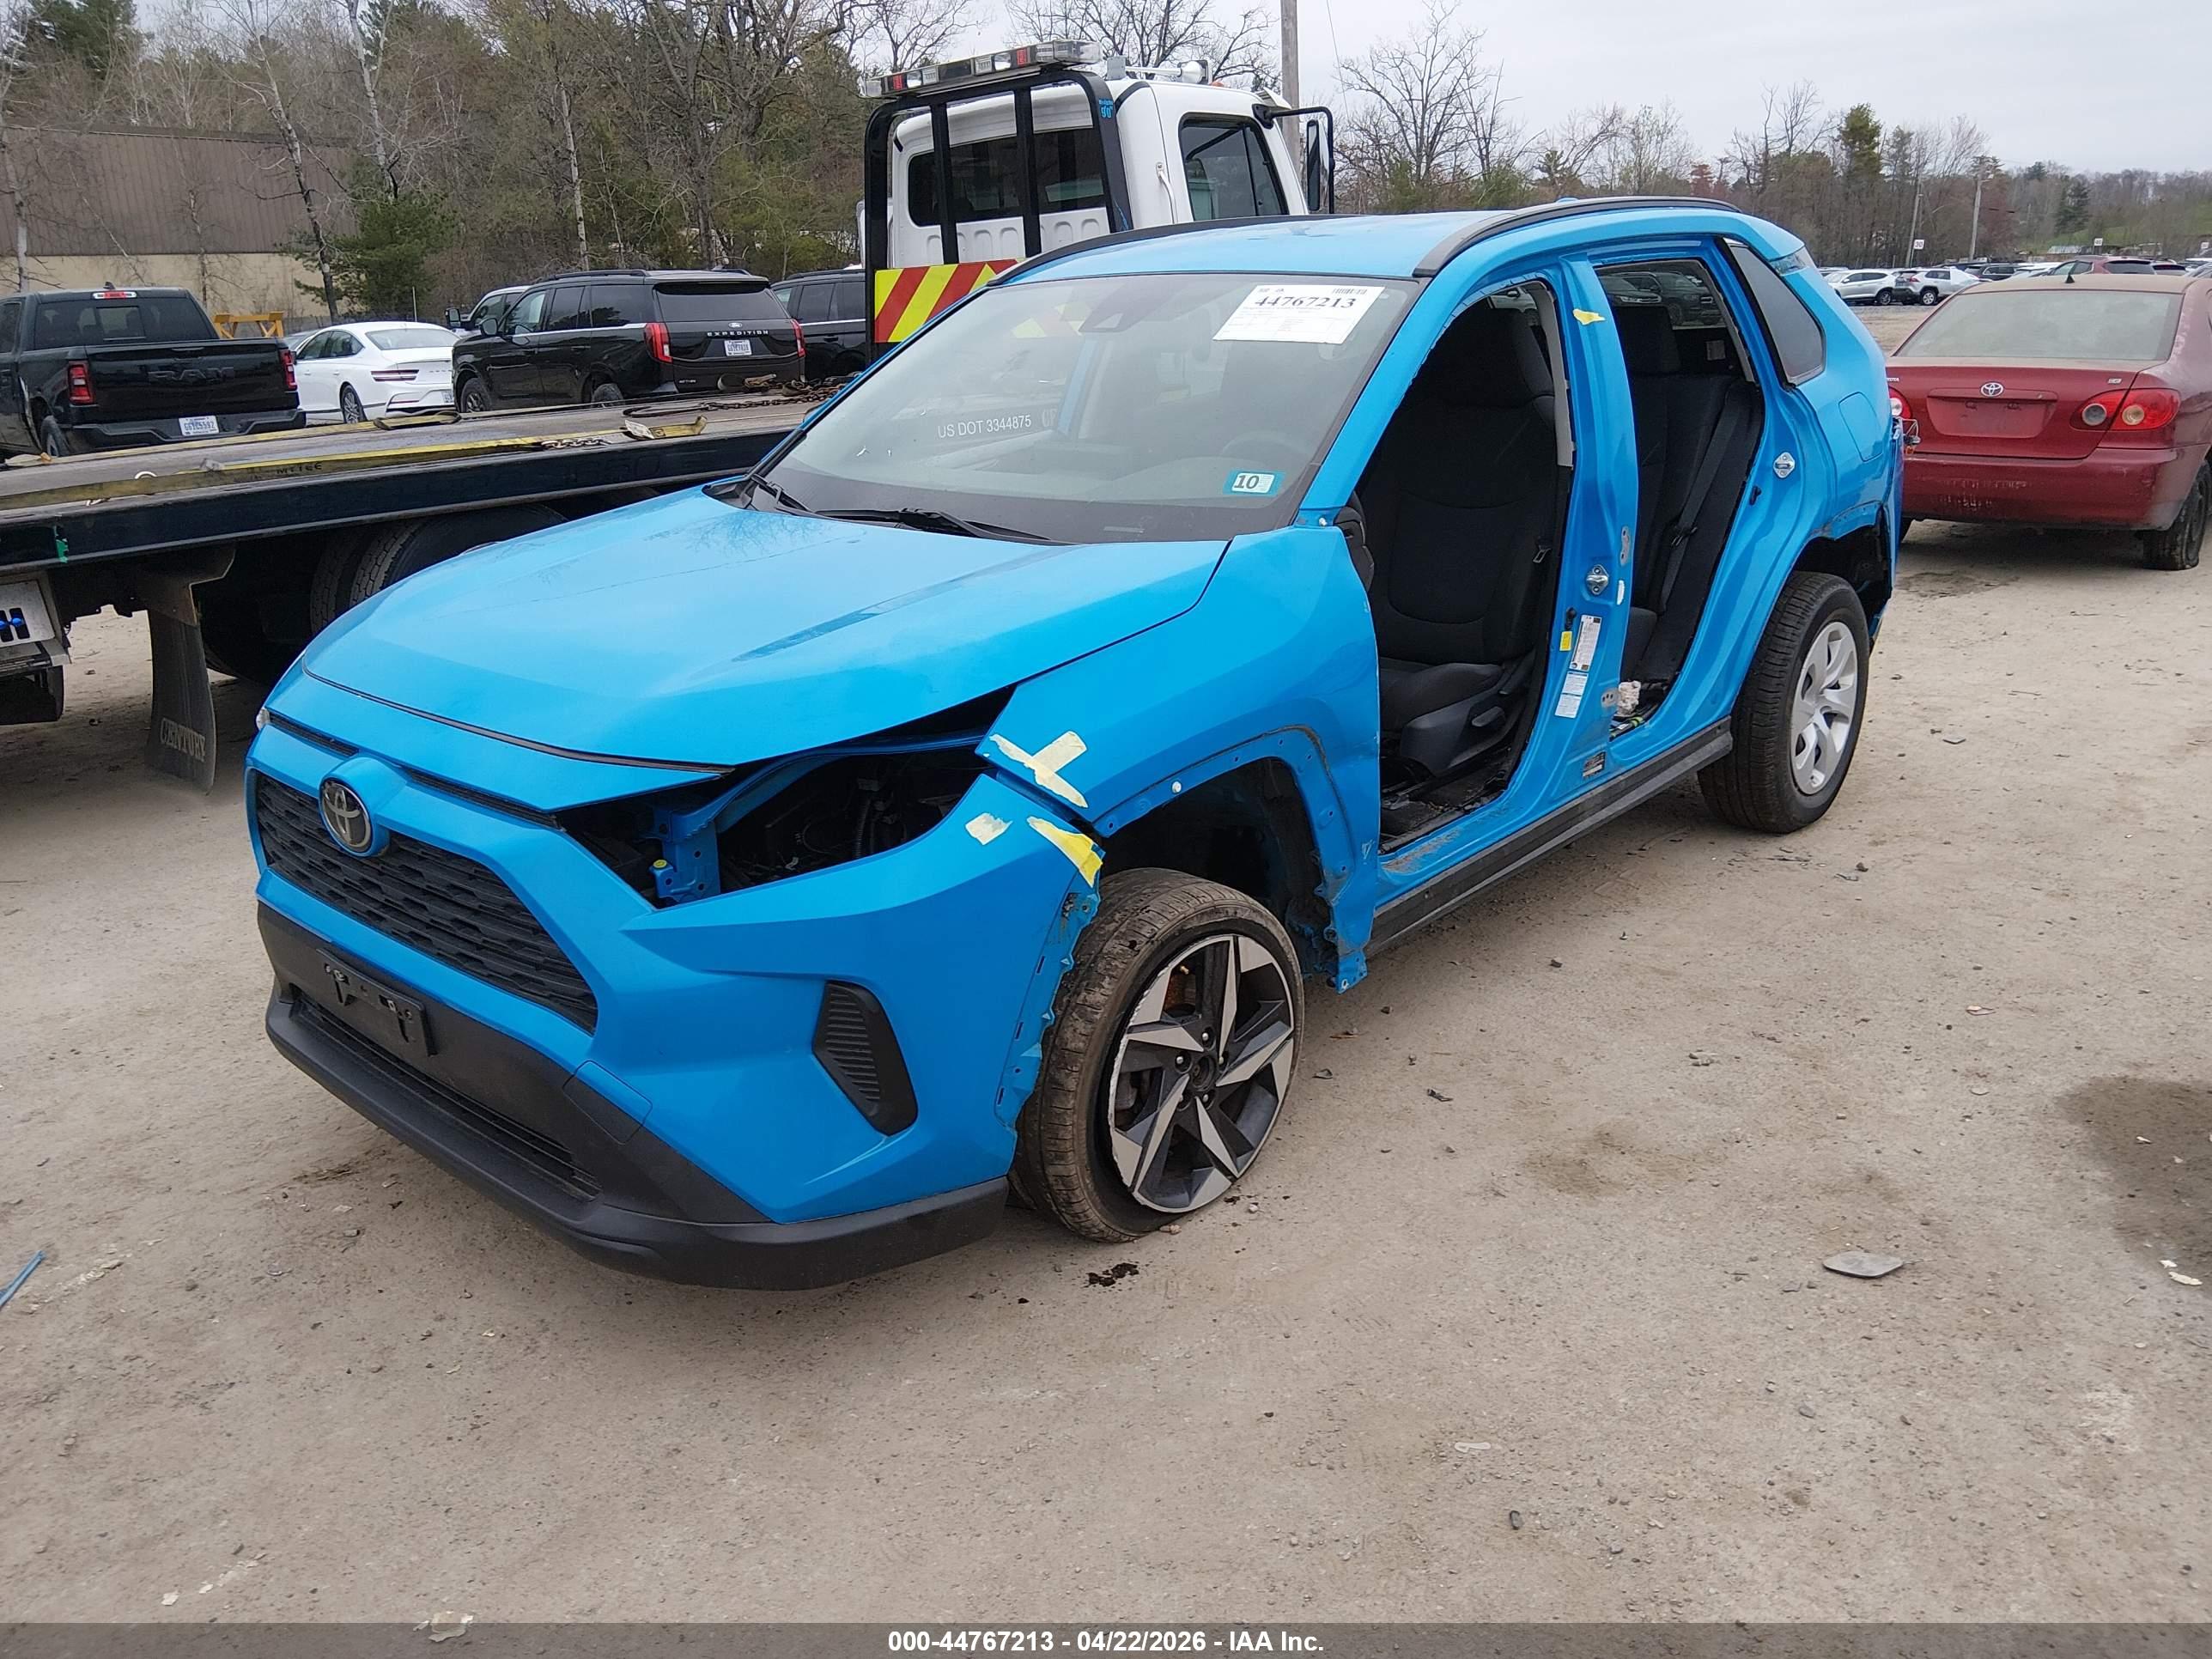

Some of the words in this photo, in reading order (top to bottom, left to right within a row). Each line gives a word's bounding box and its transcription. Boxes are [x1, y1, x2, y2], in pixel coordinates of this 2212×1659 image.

[1255, 295, 1357, 309] 44767213
[147, 367, 234, 384] RAM
[937, 423, 956, 439] US
[957, 420, 984, 436] DOT
[986, 415, 1032, 433] 3344875
[1234, 475, 1260, 489] 10
[160, 717, 206, 763] CENTURY
